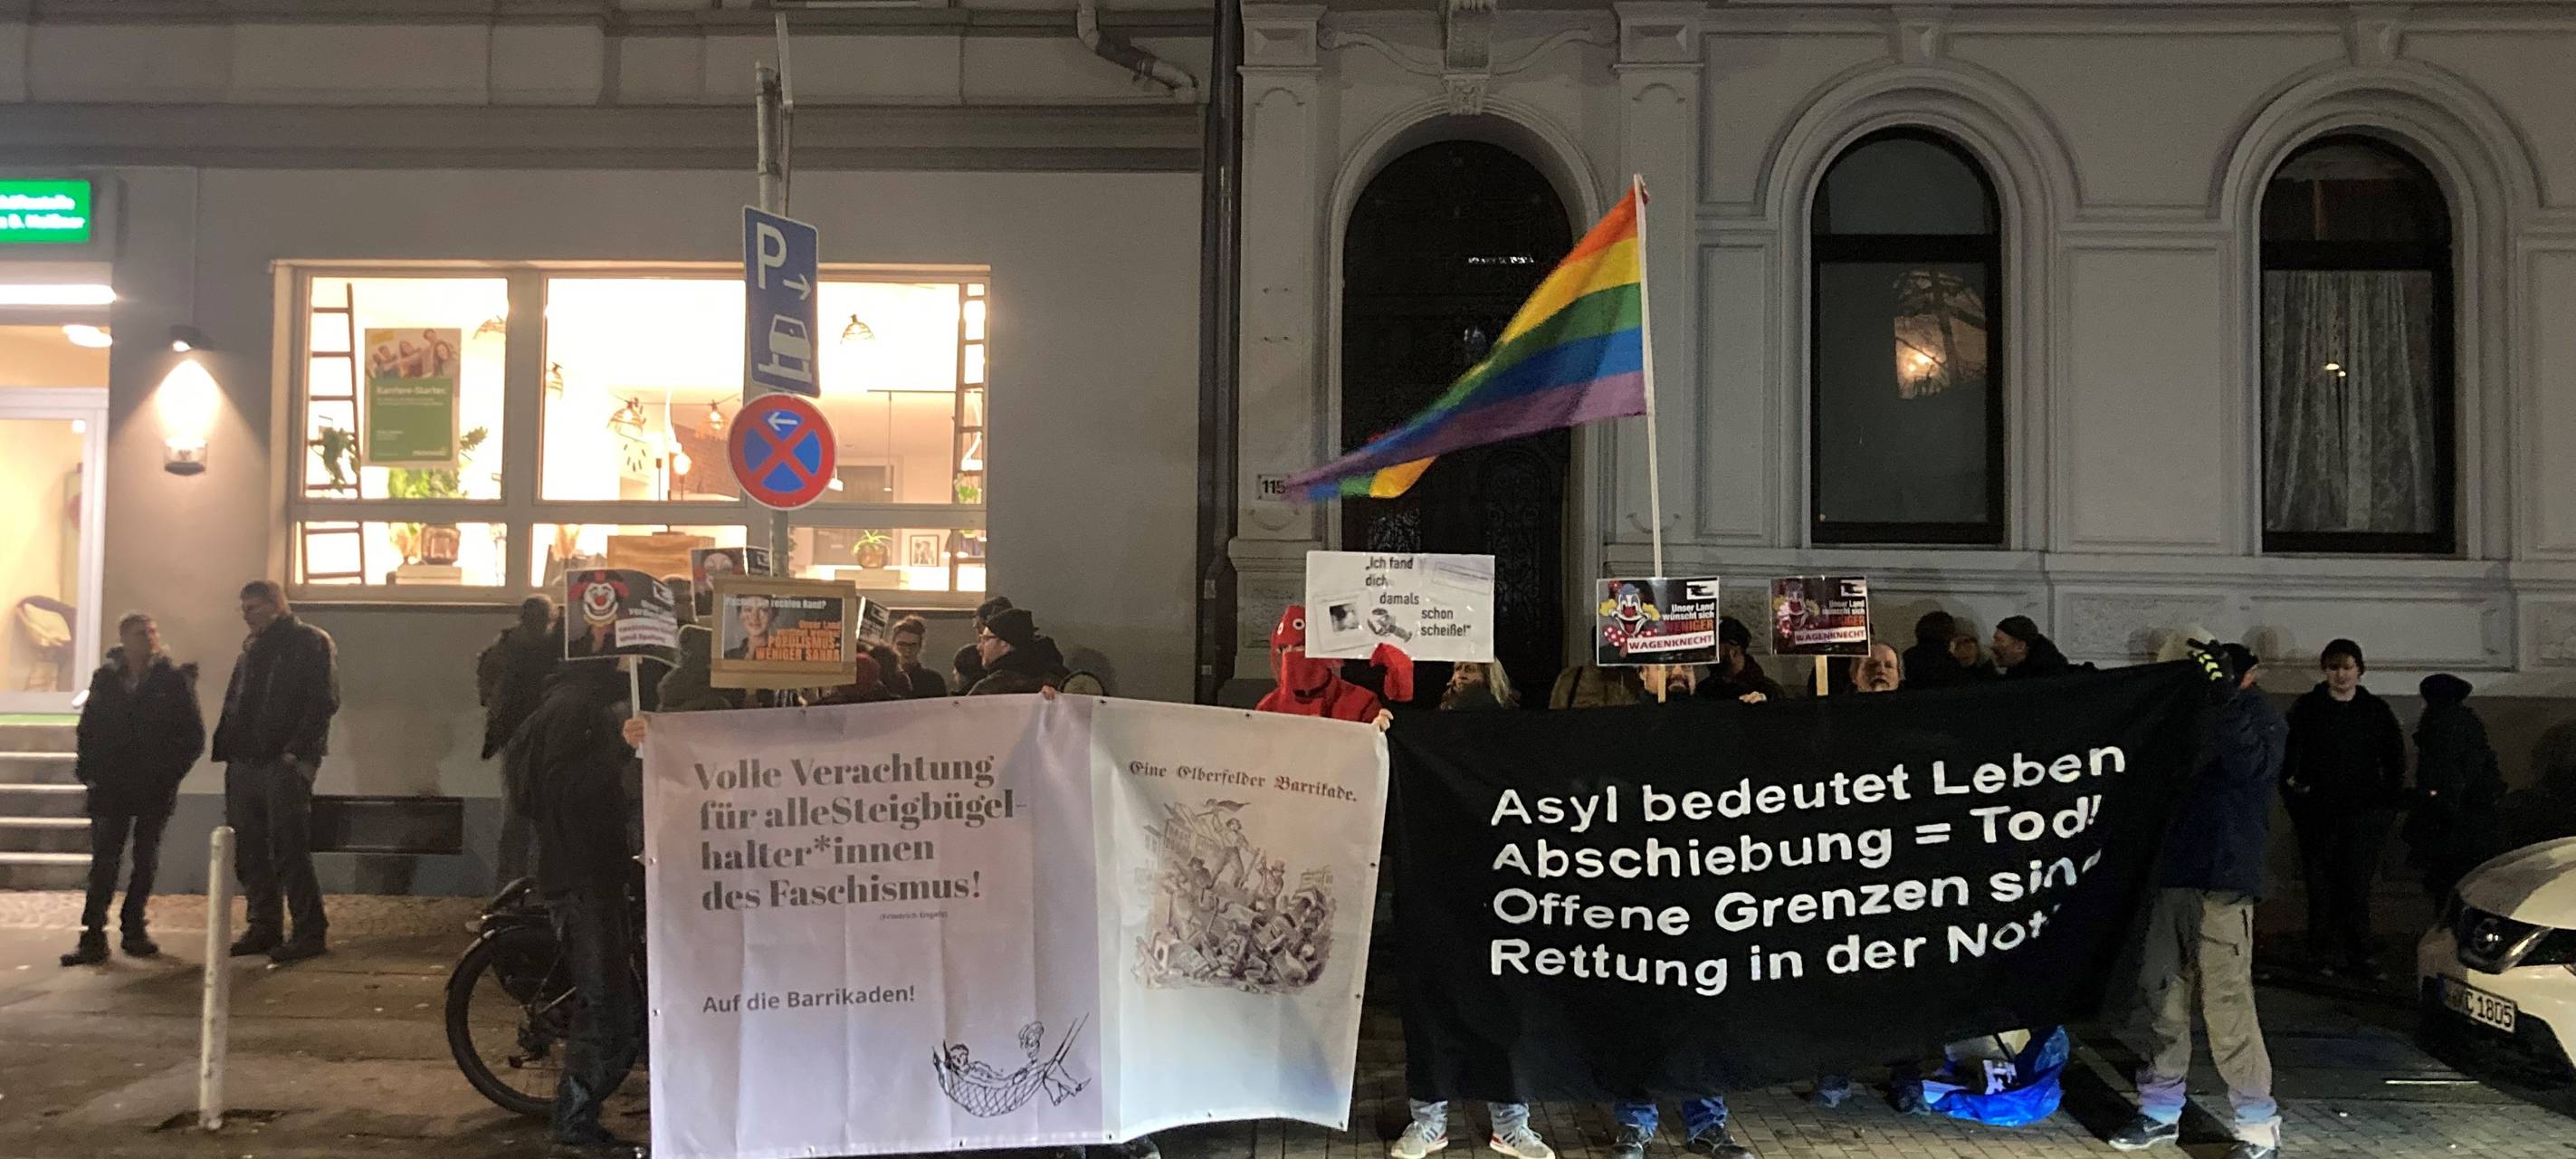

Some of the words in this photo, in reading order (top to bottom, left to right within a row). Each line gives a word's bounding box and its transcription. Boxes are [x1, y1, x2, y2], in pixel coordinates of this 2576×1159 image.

[757, 222, 787, 290] P
[1262, 479, 1286, 494] 115
[1389, 557, 1414, 570] fand
[1365, 573, 1388, 587] dich
[1379, 591, 1420, 605] damals
[1672, 604, 1694, 613] Unser
[1696, 601, 1715, 611] Land
[1421, 607, 1454, 620] schon
[1663, 612, 1697, 621] wünscht
[1698, 610, 1715, 619] sich
[1628, 635, 1713, 650] WAGENKNECHT
[1795, 629, 1865, 642] WAGENKNECHT
[694, 759, 782, 790] Volle
[790, 752, 995, 789] Verachtung
[1129, 761, 1167, 777] Eine
[1177, 765, 1266, 788] Elberfelder
[1274, 775, 1358, 802] Barrikade.
[1490, 785, 1617, 832] Asyl
[1642, 763, 1912, 824] bedeutet
[1932, 745, 2125, 797] Leben
[700, 800, 758, 831] für
[1492, 827, 1894, 878] Abschiebung
[1969, 794, 2103, 844] Tod!
[702, 881, 760, 911] des
[769, 870, 981, 906] Faschismus!
[1493, 887, 1690, 936] Offene
[1714, 873, 1970, 934] Grenzen
[1491, 938, 1729, 997] Rettung
[1750, 945, 1804, 982] in
[1827, 933, 1927, 975] der
[702, 993, 740, 1013] Auf
[746, 991, 780, 1011] die
[787, 985, 915, 1008] Barrikaden!
[2476, 996, 2513, 1028] 1805
